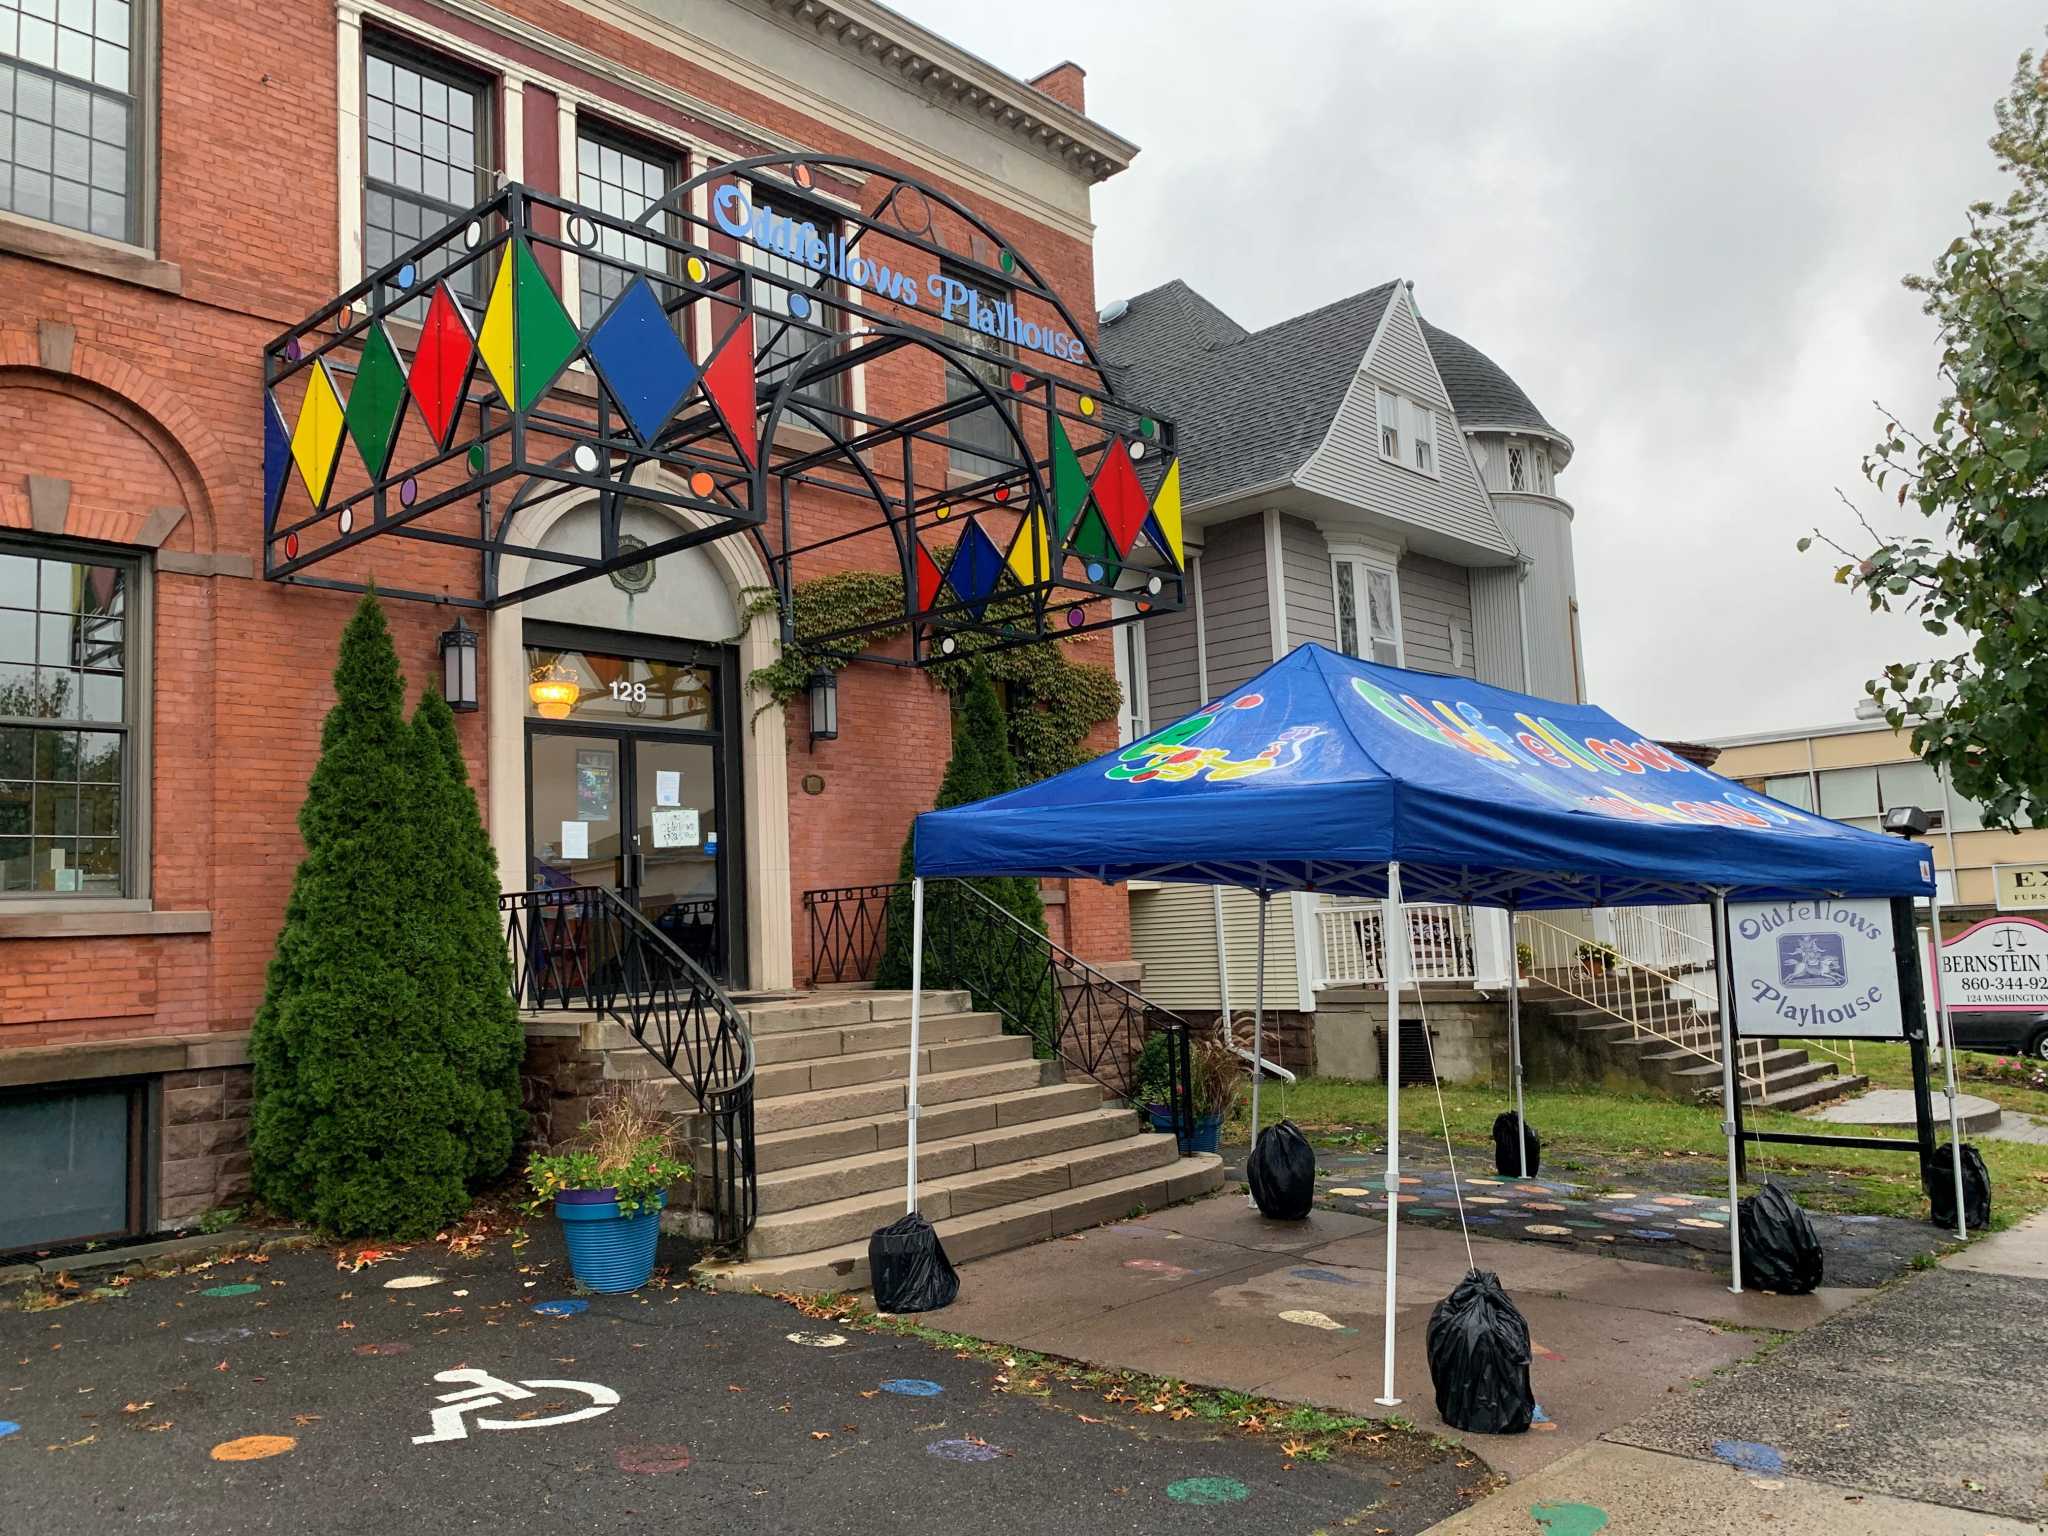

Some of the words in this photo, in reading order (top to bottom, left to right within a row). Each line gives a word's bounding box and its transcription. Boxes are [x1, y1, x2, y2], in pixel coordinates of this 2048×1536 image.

[713, 184, 918, 306] Oddfellows
[609, 681, 647, 702] 128
[1739, 900, 1882, 940] Oddfellows
[1943, 954, 2040, 973] BERNSTEIN
[1751, 979, 1882, 1027] Playhouse
[1967, 994, 1981, 1002] 124
